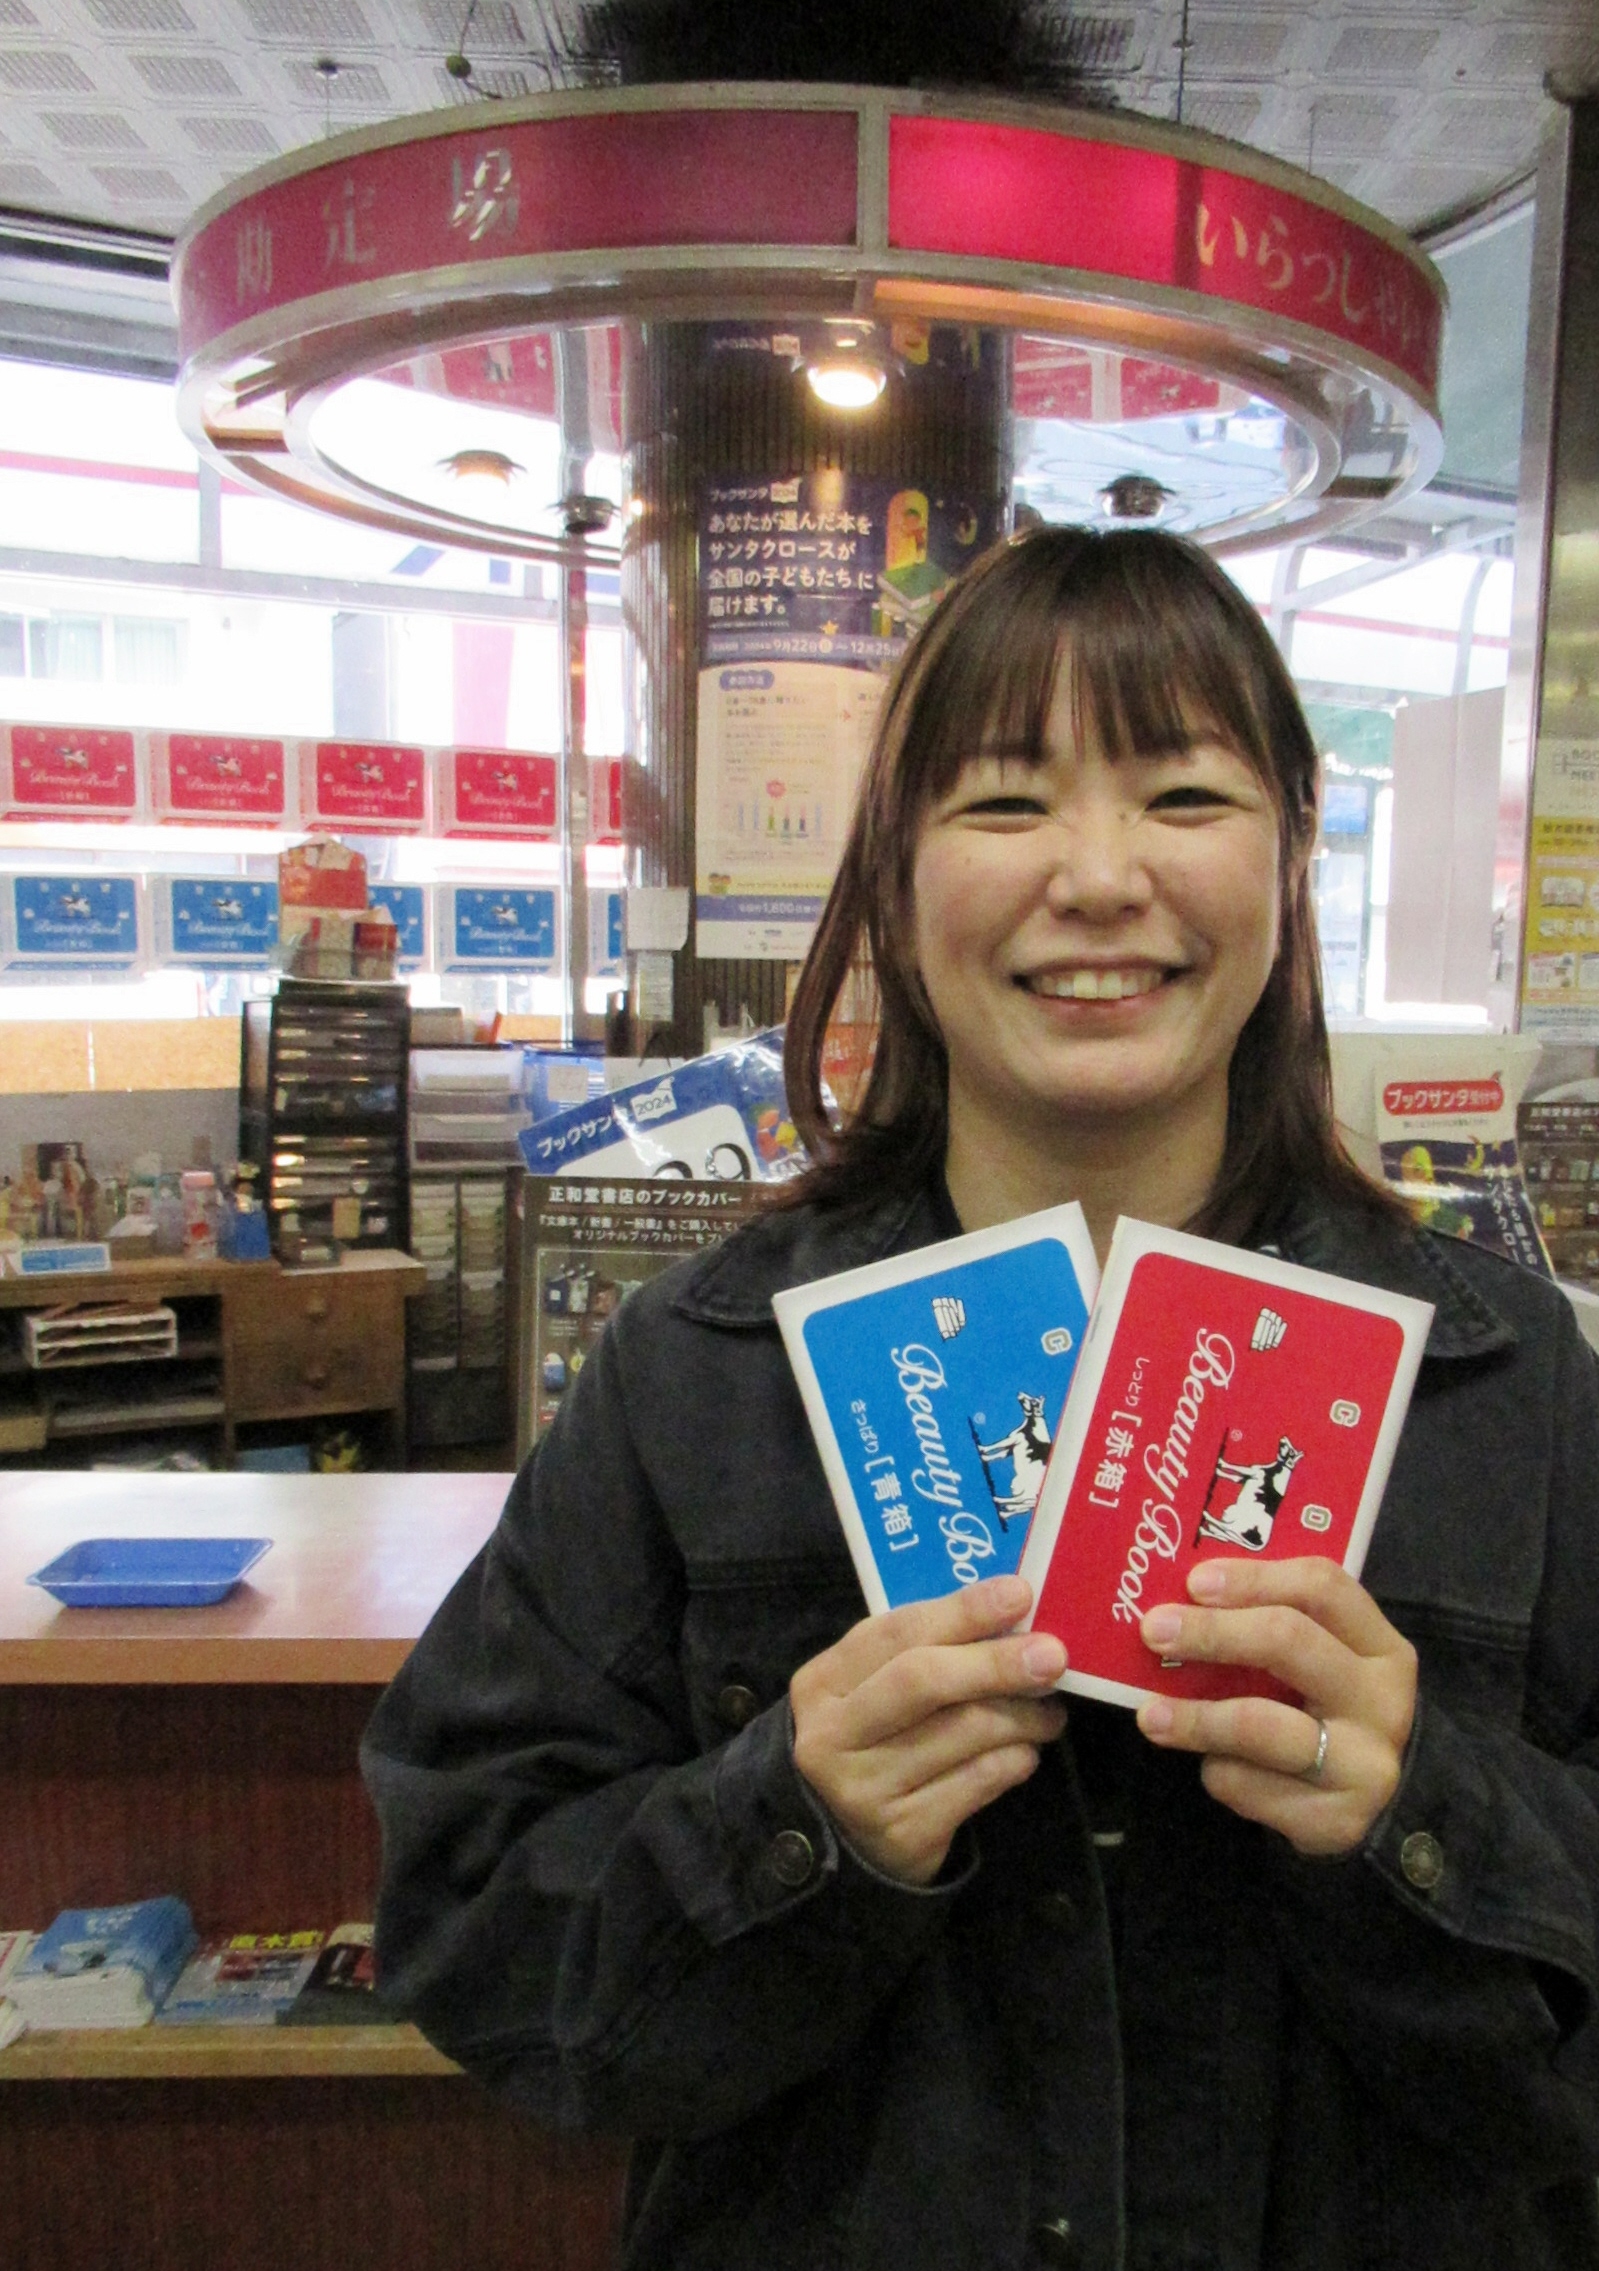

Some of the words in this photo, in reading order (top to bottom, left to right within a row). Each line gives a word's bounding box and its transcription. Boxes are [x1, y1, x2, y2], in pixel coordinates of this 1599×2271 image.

[708, 540, 856, 561] サンタクロースが
[635, 1095, 671, 1116] 2024
[891, 1344, 963, 1508] Beauty
[939, 1512, 996, 1588] Bo
[1143, 1328, 1235, 1501] Beauty
[1112, 1499, 1182, 1623] Book
